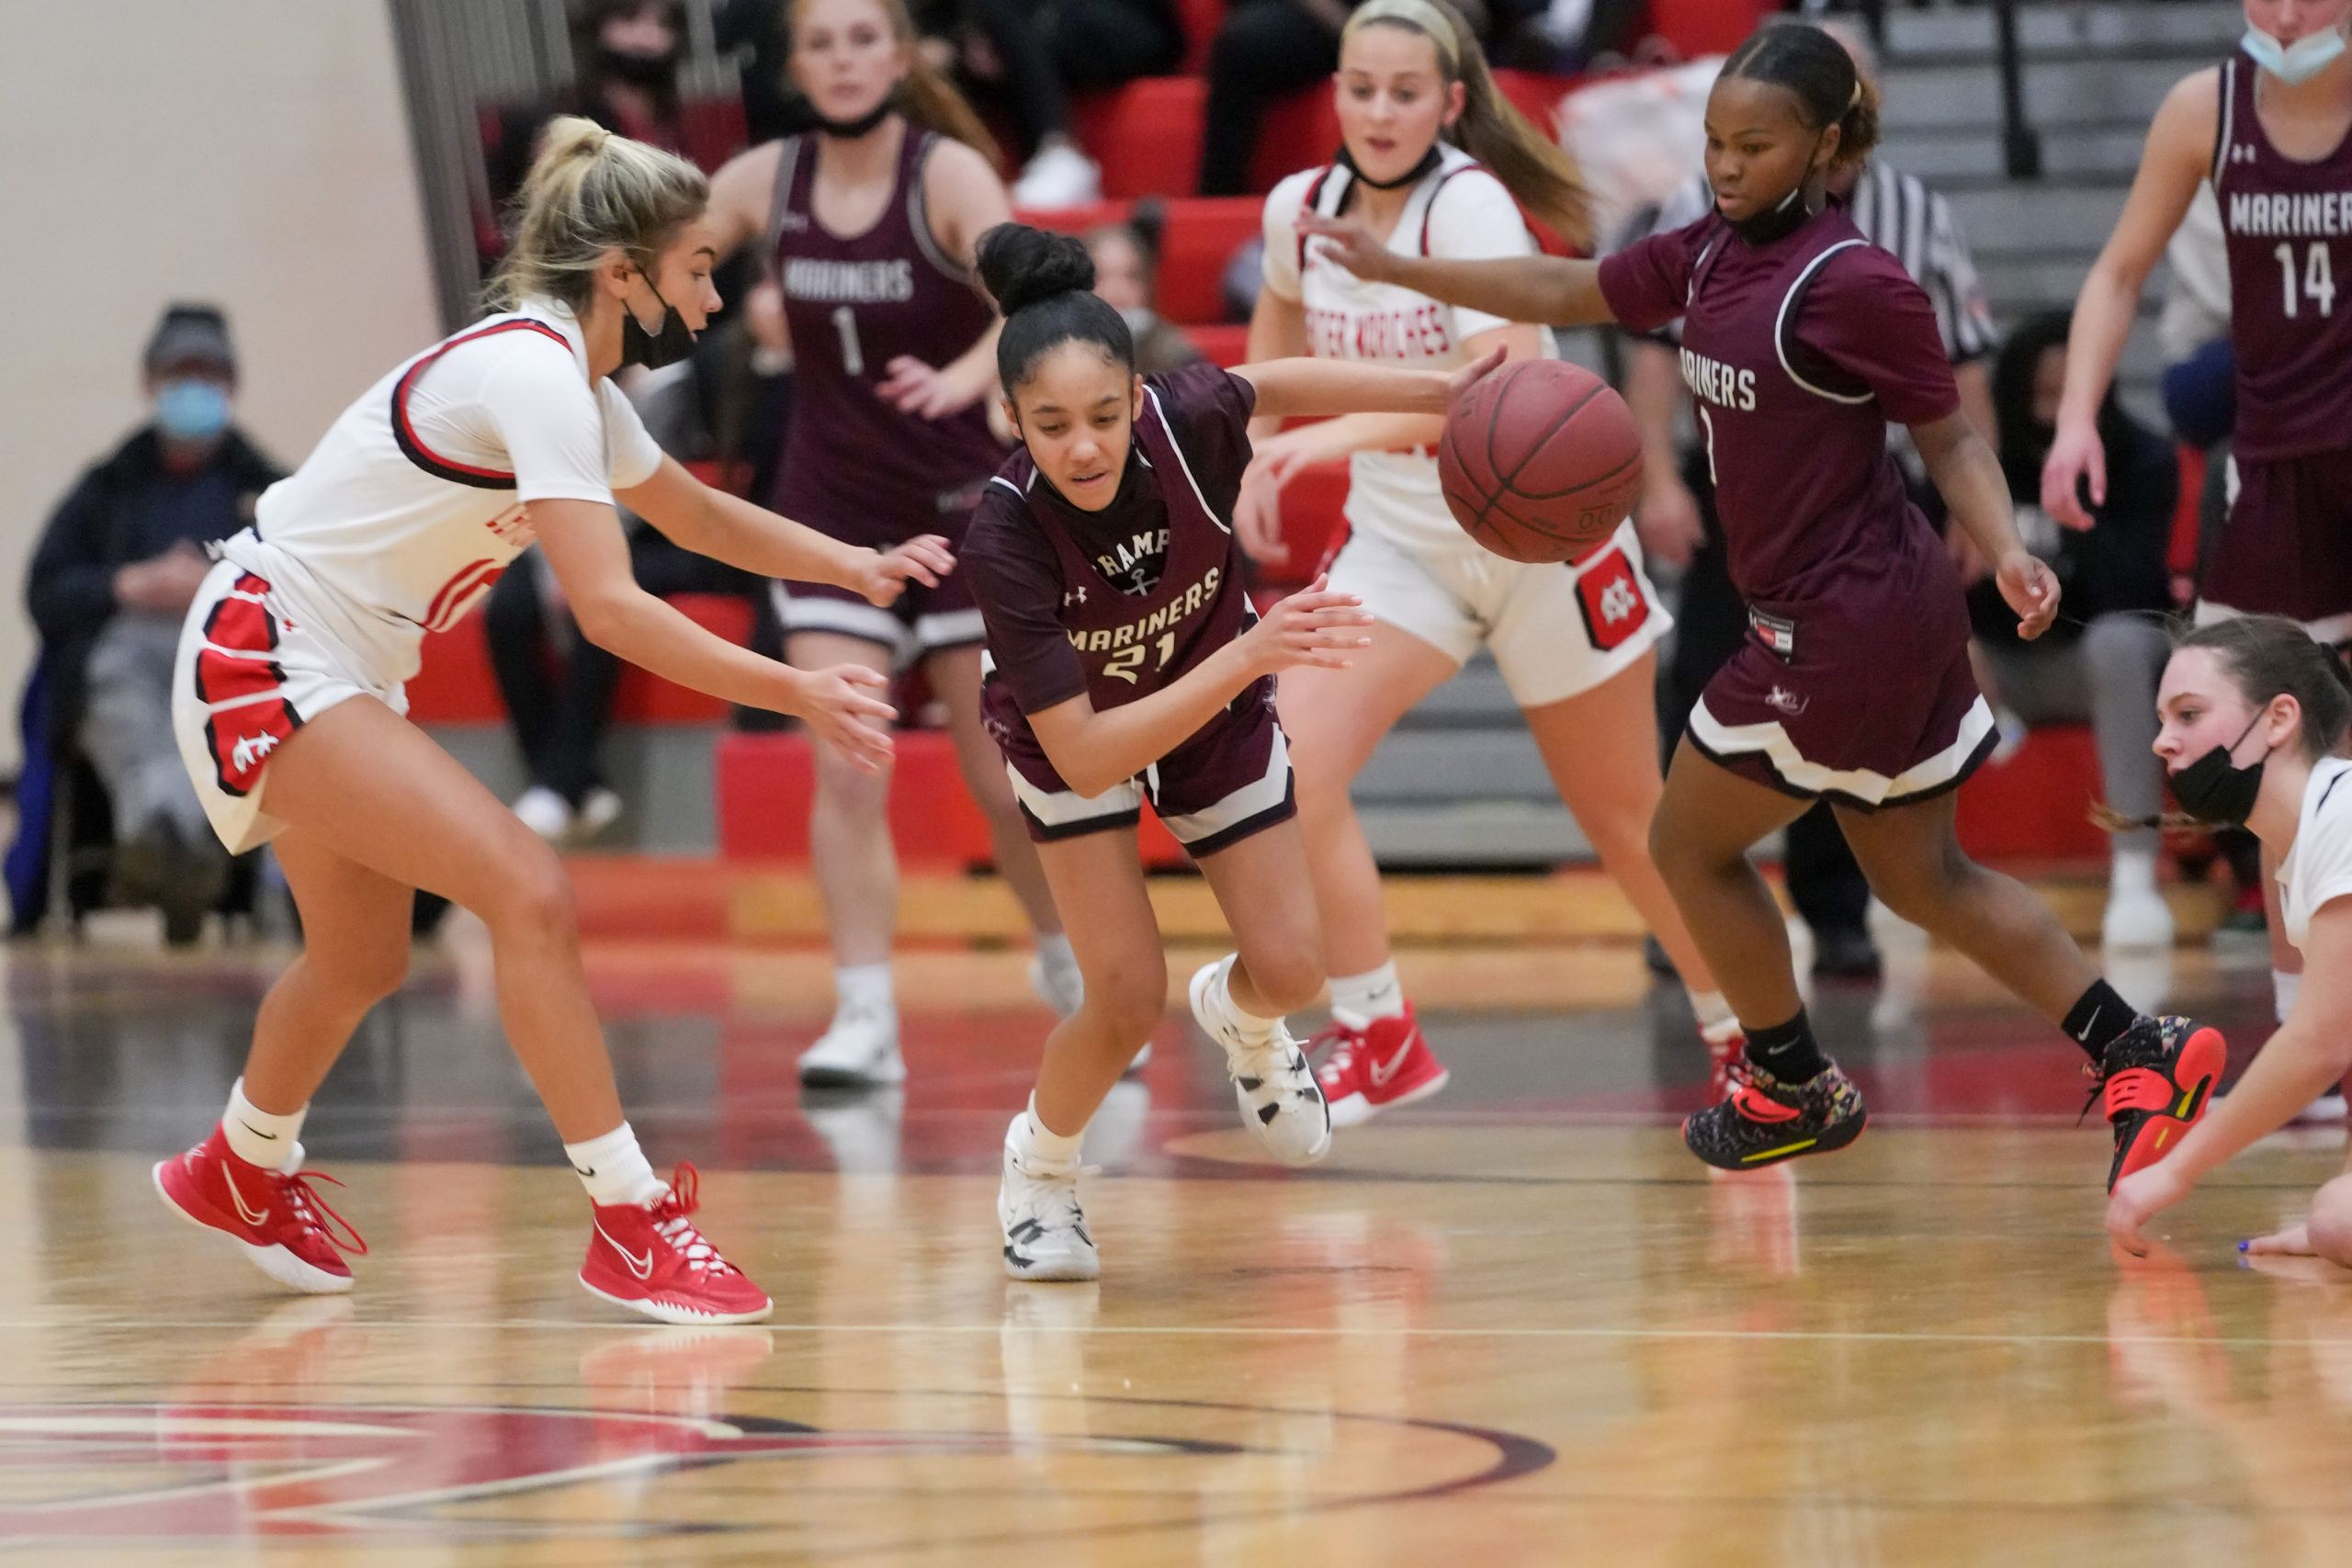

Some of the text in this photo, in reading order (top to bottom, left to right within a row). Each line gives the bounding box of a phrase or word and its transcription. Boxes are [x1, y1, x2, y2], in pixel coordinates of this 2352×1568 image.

[785, 257, 914, 303] MARINERS
[2274, 242, 2335, 318] 14
[833, 306, 864, 376] 1
[1067, 567, 1220, 652] MARINERS
[1102, 631, 1176, 685] 21
